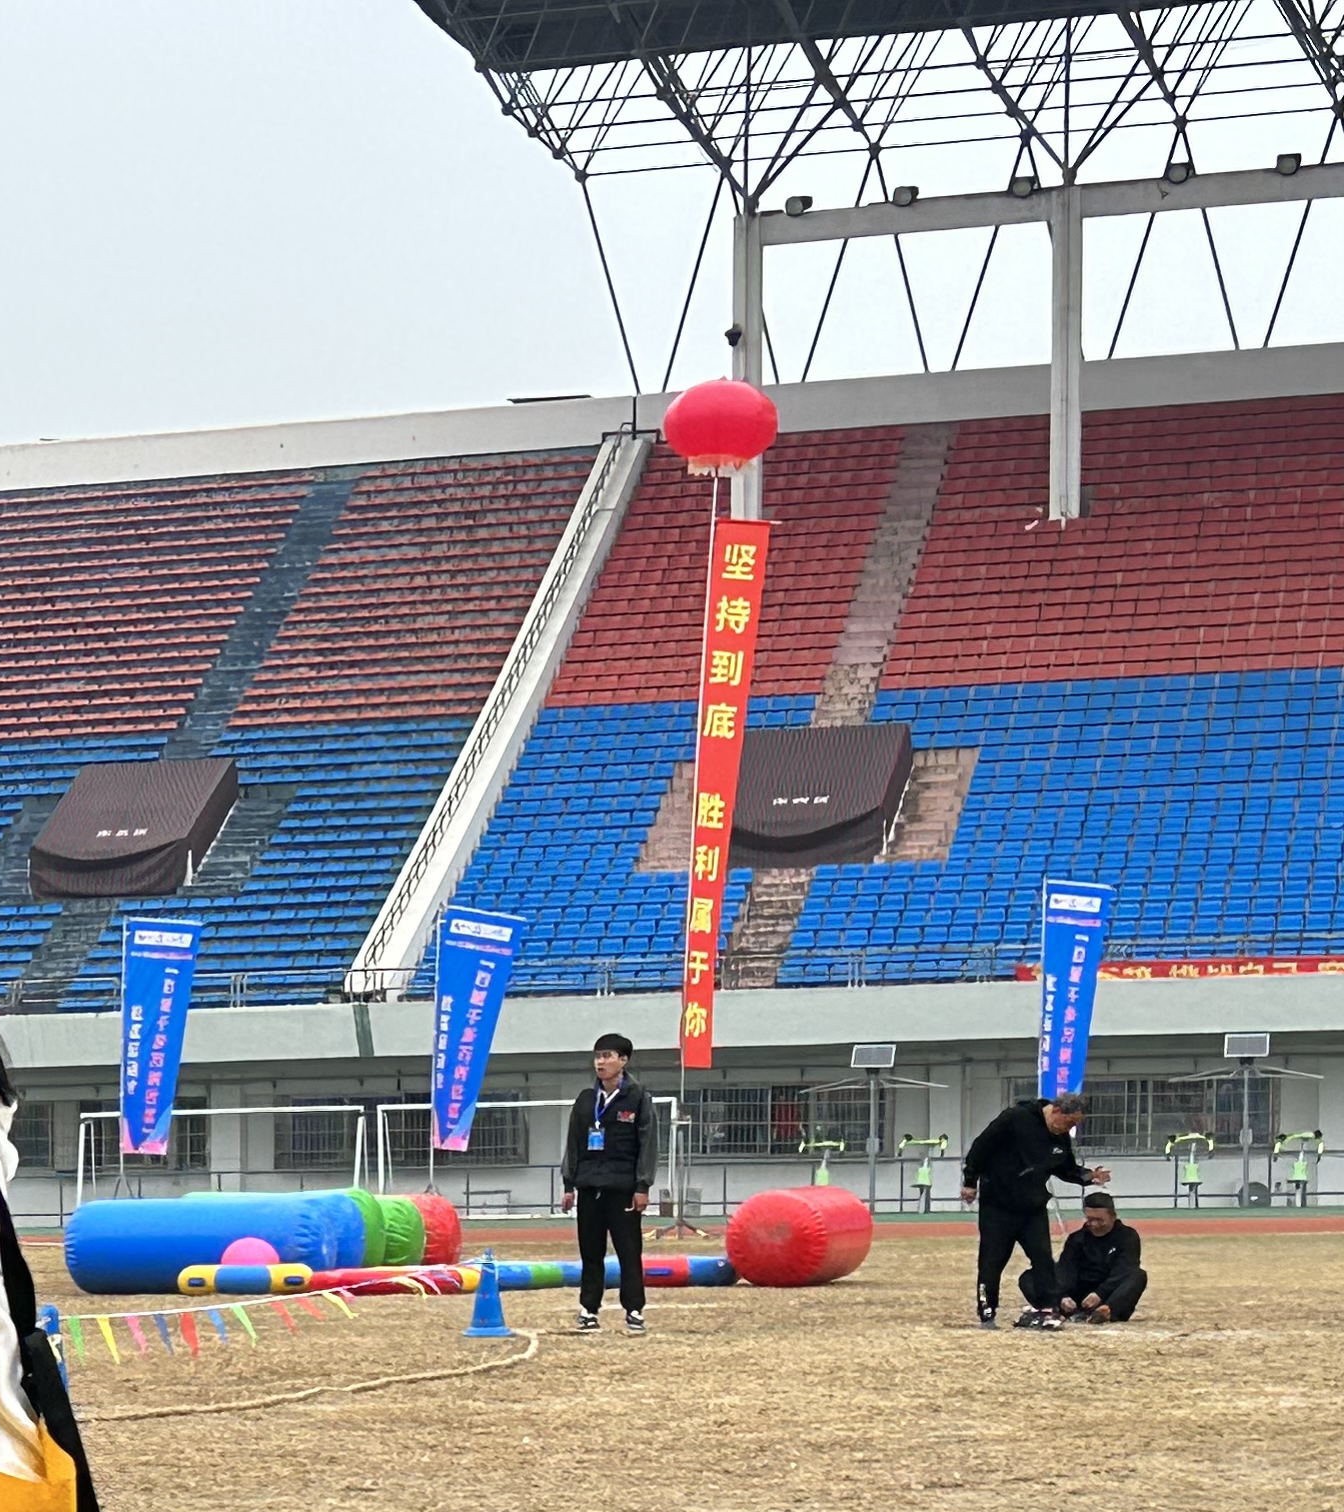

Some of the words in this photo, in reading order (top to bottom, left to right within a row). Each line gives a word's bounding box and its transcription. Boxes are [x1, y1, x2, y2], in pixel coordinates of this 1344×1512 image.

[703, 543, 758, 740] 坚持到底
[683, 792, 726, 1038] 胜利属于你
